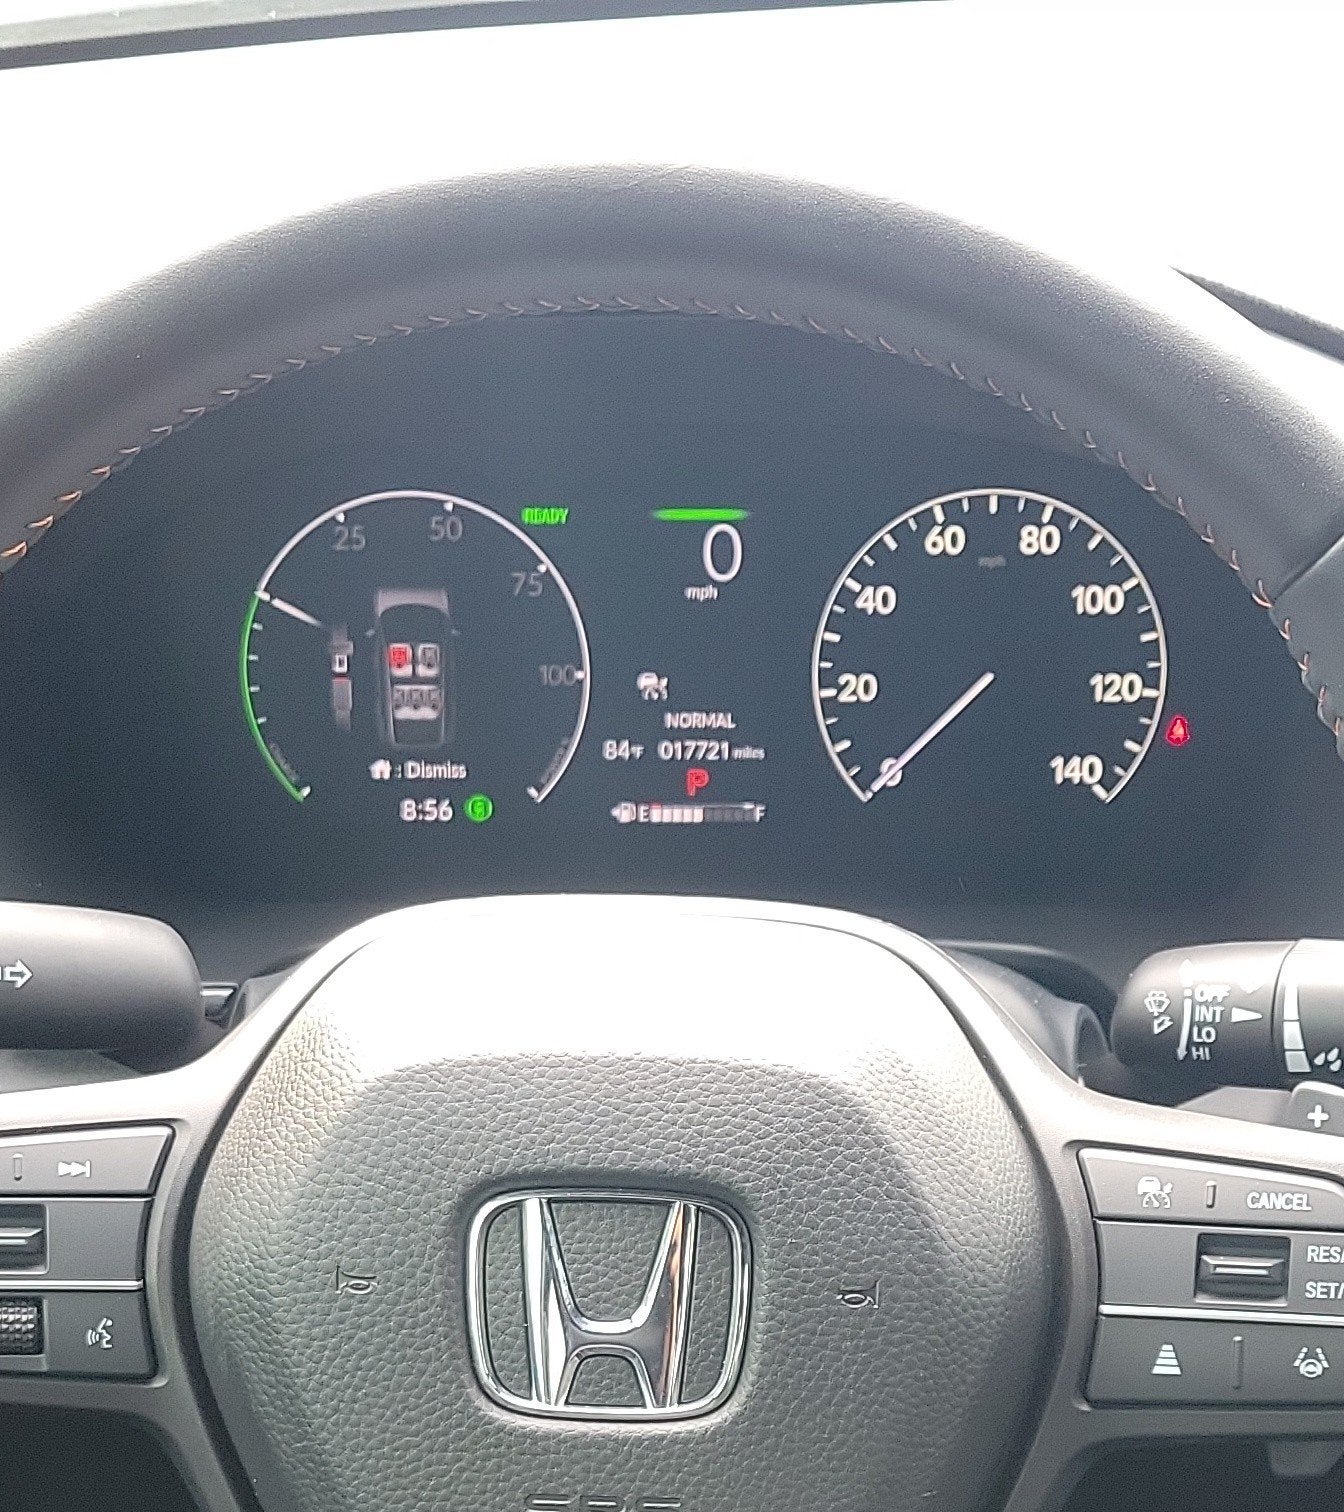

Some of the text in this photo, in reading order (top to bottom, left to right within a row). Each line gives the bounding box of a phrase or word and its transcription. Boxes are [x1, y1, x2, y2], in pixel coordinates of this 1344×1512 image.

[521, 507, 569, 525] READY
[333, 525, 366, 551] 25
[430, 516, 462, 542] 50
[924, 524, 966, 556] 60
[1019, 524, 1061, 556] 80
[703, 522, 743, 582] 0
[512, 572, 544, 598] 75
[685, 584, 718, 601] mph
[856, 585, 896, 615] 40
[1072, 584, 1125, 615] 100
[540, 665, 575, 687] 100
[837, 672, 878, 703] 20
[1090, 672, 1143, 703] 120
[665, 712, 736, 730] NORMAL
[658, 740, 729, 760] 017721
[732, 744, 765, 761] miles
[406, 759, 467, 780] Dismiss
[1050, 755, 1103, 785] 140
[687, 768, 709, 796] P
[400, 799, 454, 821] 8:56
[1194, 985, 1230, 1003] OFF
[1195, 1005, 1224, 1024] INT
[1193, 1025, 1216, 1044] LO
[1191, 1046, 1211, 1062] HI
[1246, 1191, 1312, 1212] CANCEL
